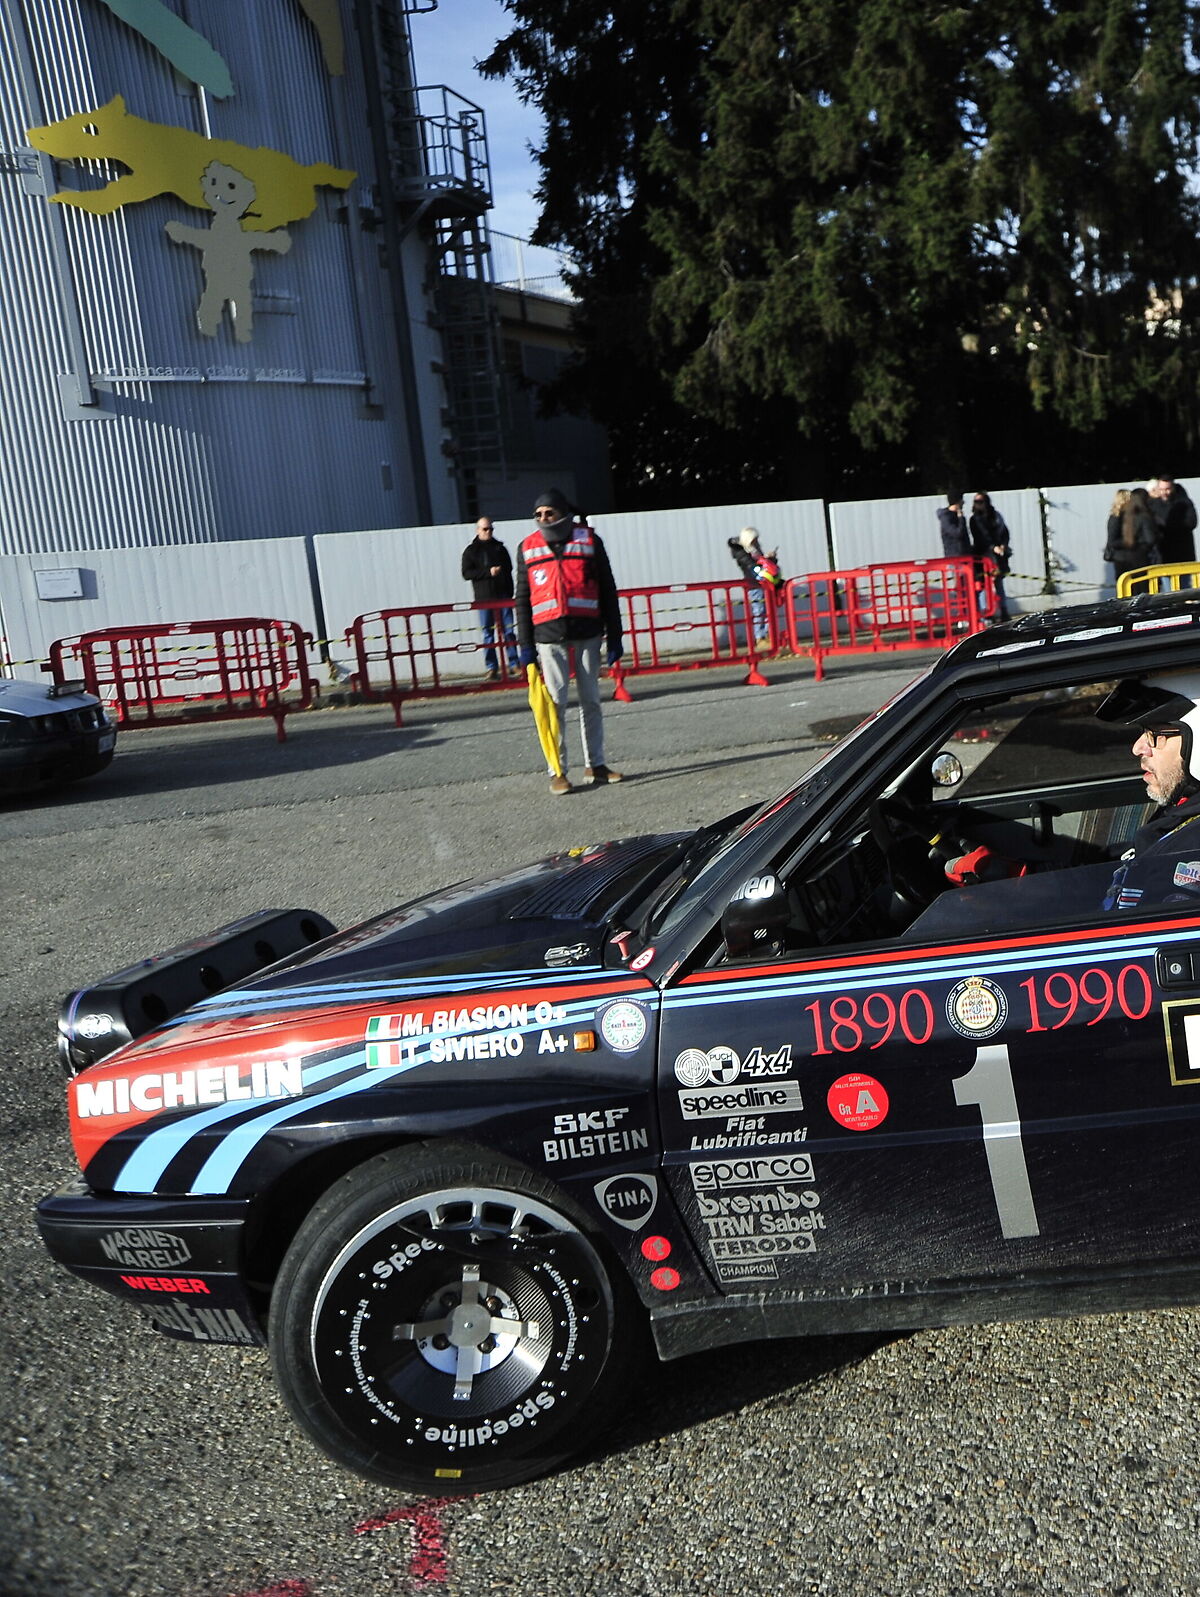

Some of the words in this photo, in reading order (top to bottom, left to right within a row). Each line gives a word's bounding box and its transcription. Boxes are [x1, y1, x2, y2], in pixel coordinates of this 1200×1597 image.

[1020, 963, 1153, 1033] 1990
[401, 1013, 430, 1037] M.
[432, 1003, 526, 1032] BIASION
[534, 1000, 567, 1023] O+
[805, 988, 935, 1057] 1890
[432, 1032, 523, 1063] SIVIERO
[538, 1030, 569, 1055] A+
[709, 1051, 733, 1062] PUCH
[741, 1044, 793, 1077] 4x4
[76, 1057, 303, 1119] MICHELIN
[683, 1088, 787, 1116] speedline
[855, 1089, 880, 1114] A
[554, 1107, 629, 1135] SKF
[726, 1116, 766, 1132] Fiat
[543, 1128, 649, 1162] BILSTEIN
[690, 1127, 808, 1150] Lubrificanti
[951, 1044, 1041, 1240] 1
[694, 1157, 810, 1187] sparco
[605, 1188, 651, 1209] FINA
[696, 1186, 820, 1217] brembo
[703, 1215, 754, 1238] TRW
[760, 1210, 826, 1234] Sabelt
[713, 1235, 811, 1256] FERODO
[120, 1275, 211, 1294] WEBER
[720, 1264, 774, 1277] CHAMPION
[425, 1390, 556, 1448] Speedline
